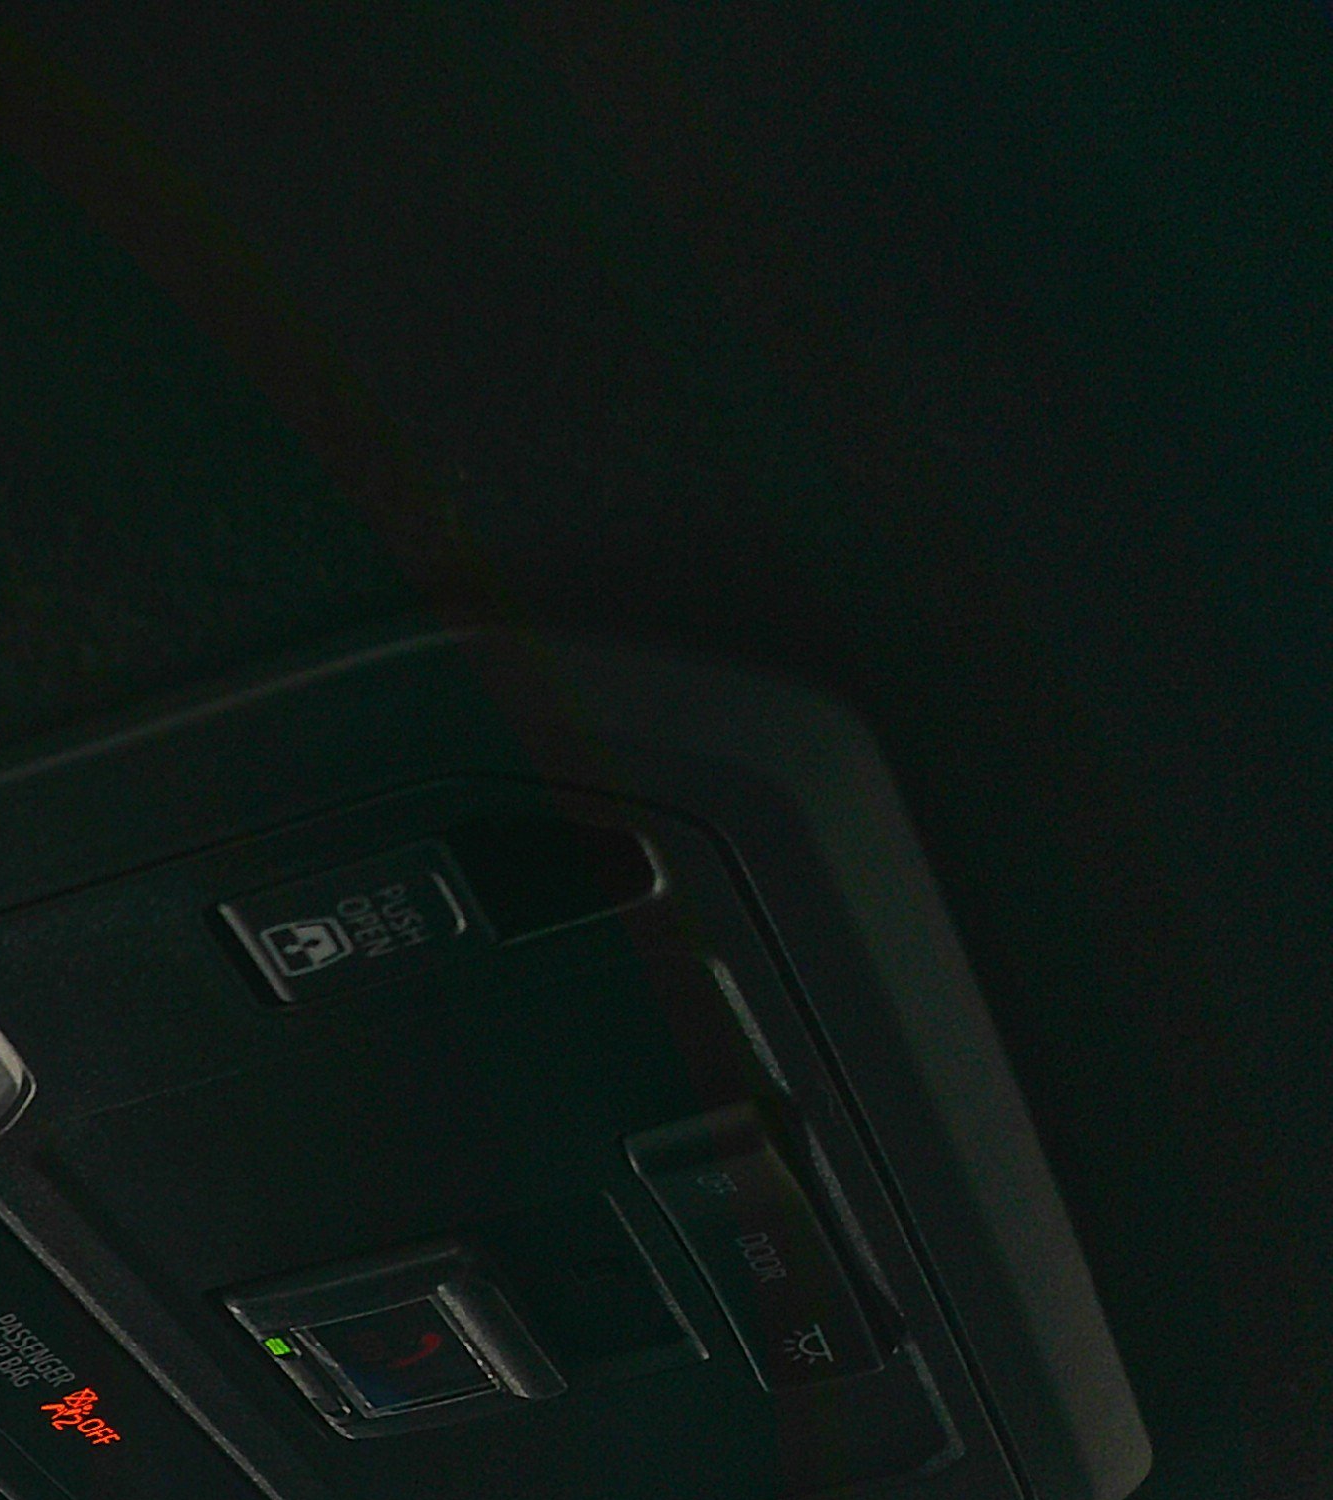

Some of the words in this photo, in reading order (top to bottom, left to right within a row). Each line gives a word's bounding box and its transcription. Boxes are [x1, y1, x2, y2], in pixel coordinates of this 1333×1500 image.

[337, 896, 397, 957] OPEN
[736, 1231, 787, 1282] DOOR
[77, 1418, 121, 1444] OFF
